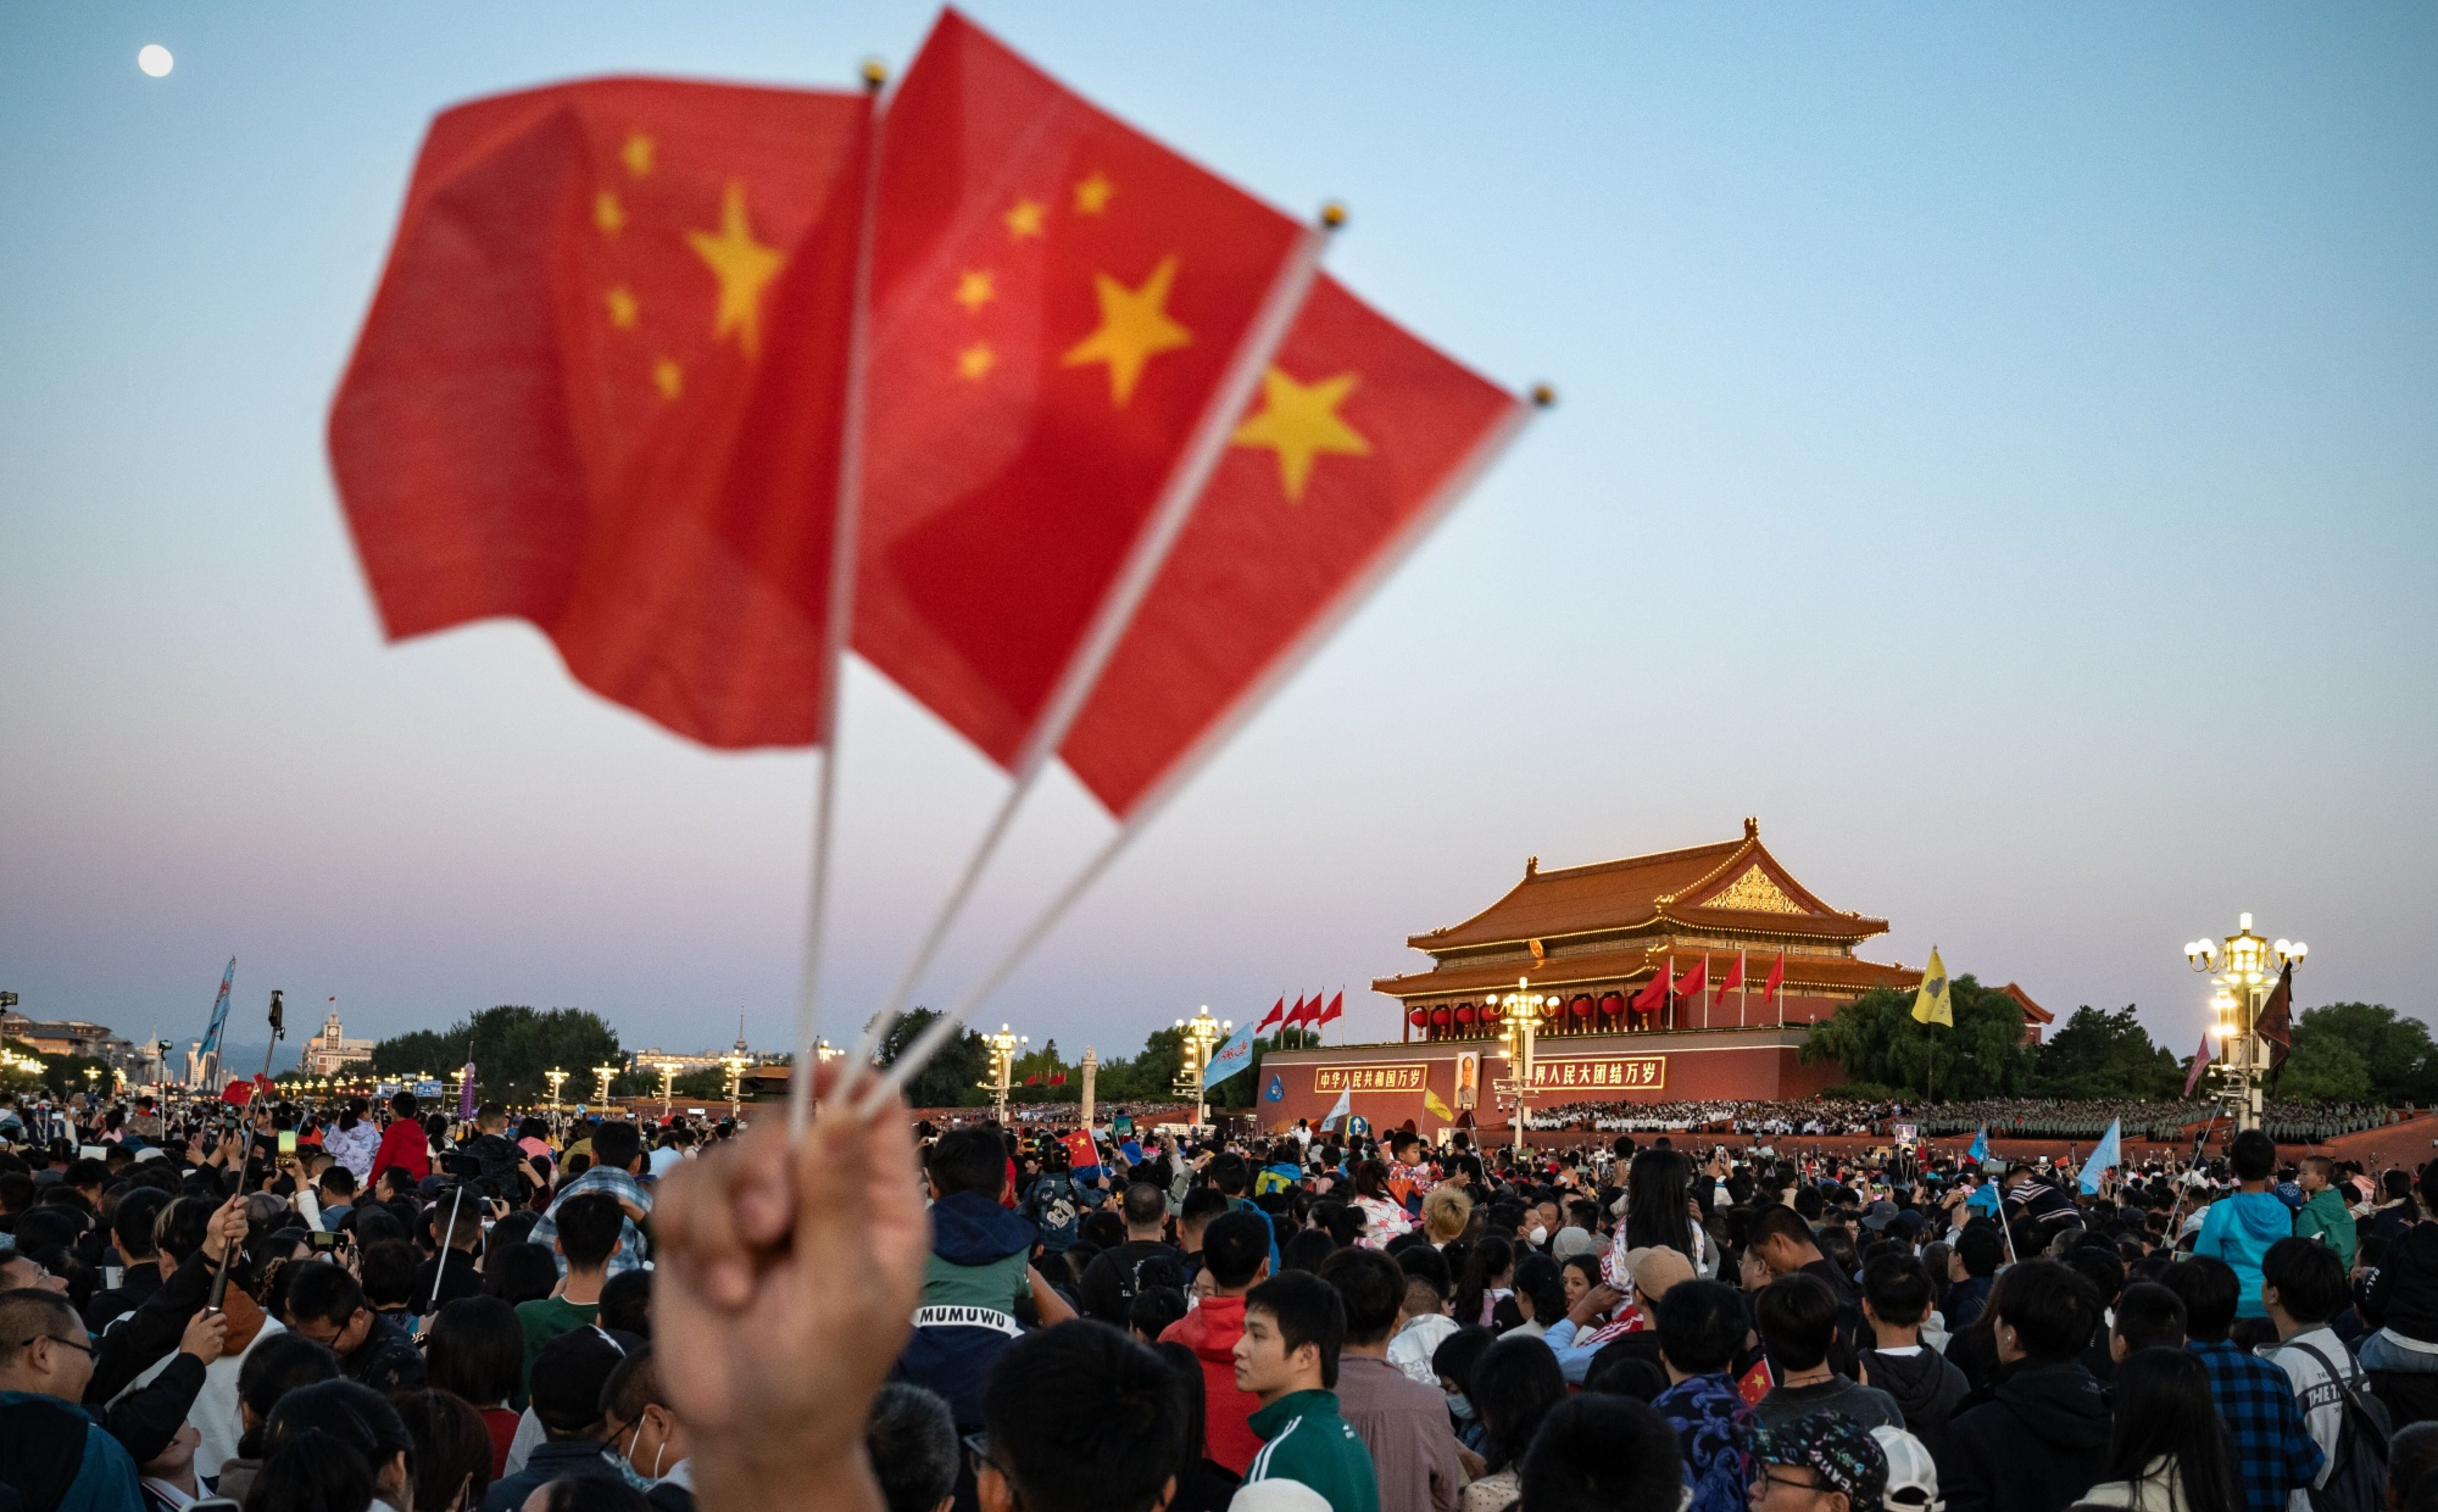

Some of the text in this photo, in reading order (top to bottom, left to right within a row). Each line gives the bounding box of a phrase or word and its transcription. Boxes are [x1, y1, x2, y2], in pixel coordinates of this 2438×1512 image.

[1321, 1069, 1420, 1088] 中华人民共和国万岁
[1535, 1062, 1656, 1085] 界人民大团结万岁
[920, 1308, 1005, 1327] MUMUWU
